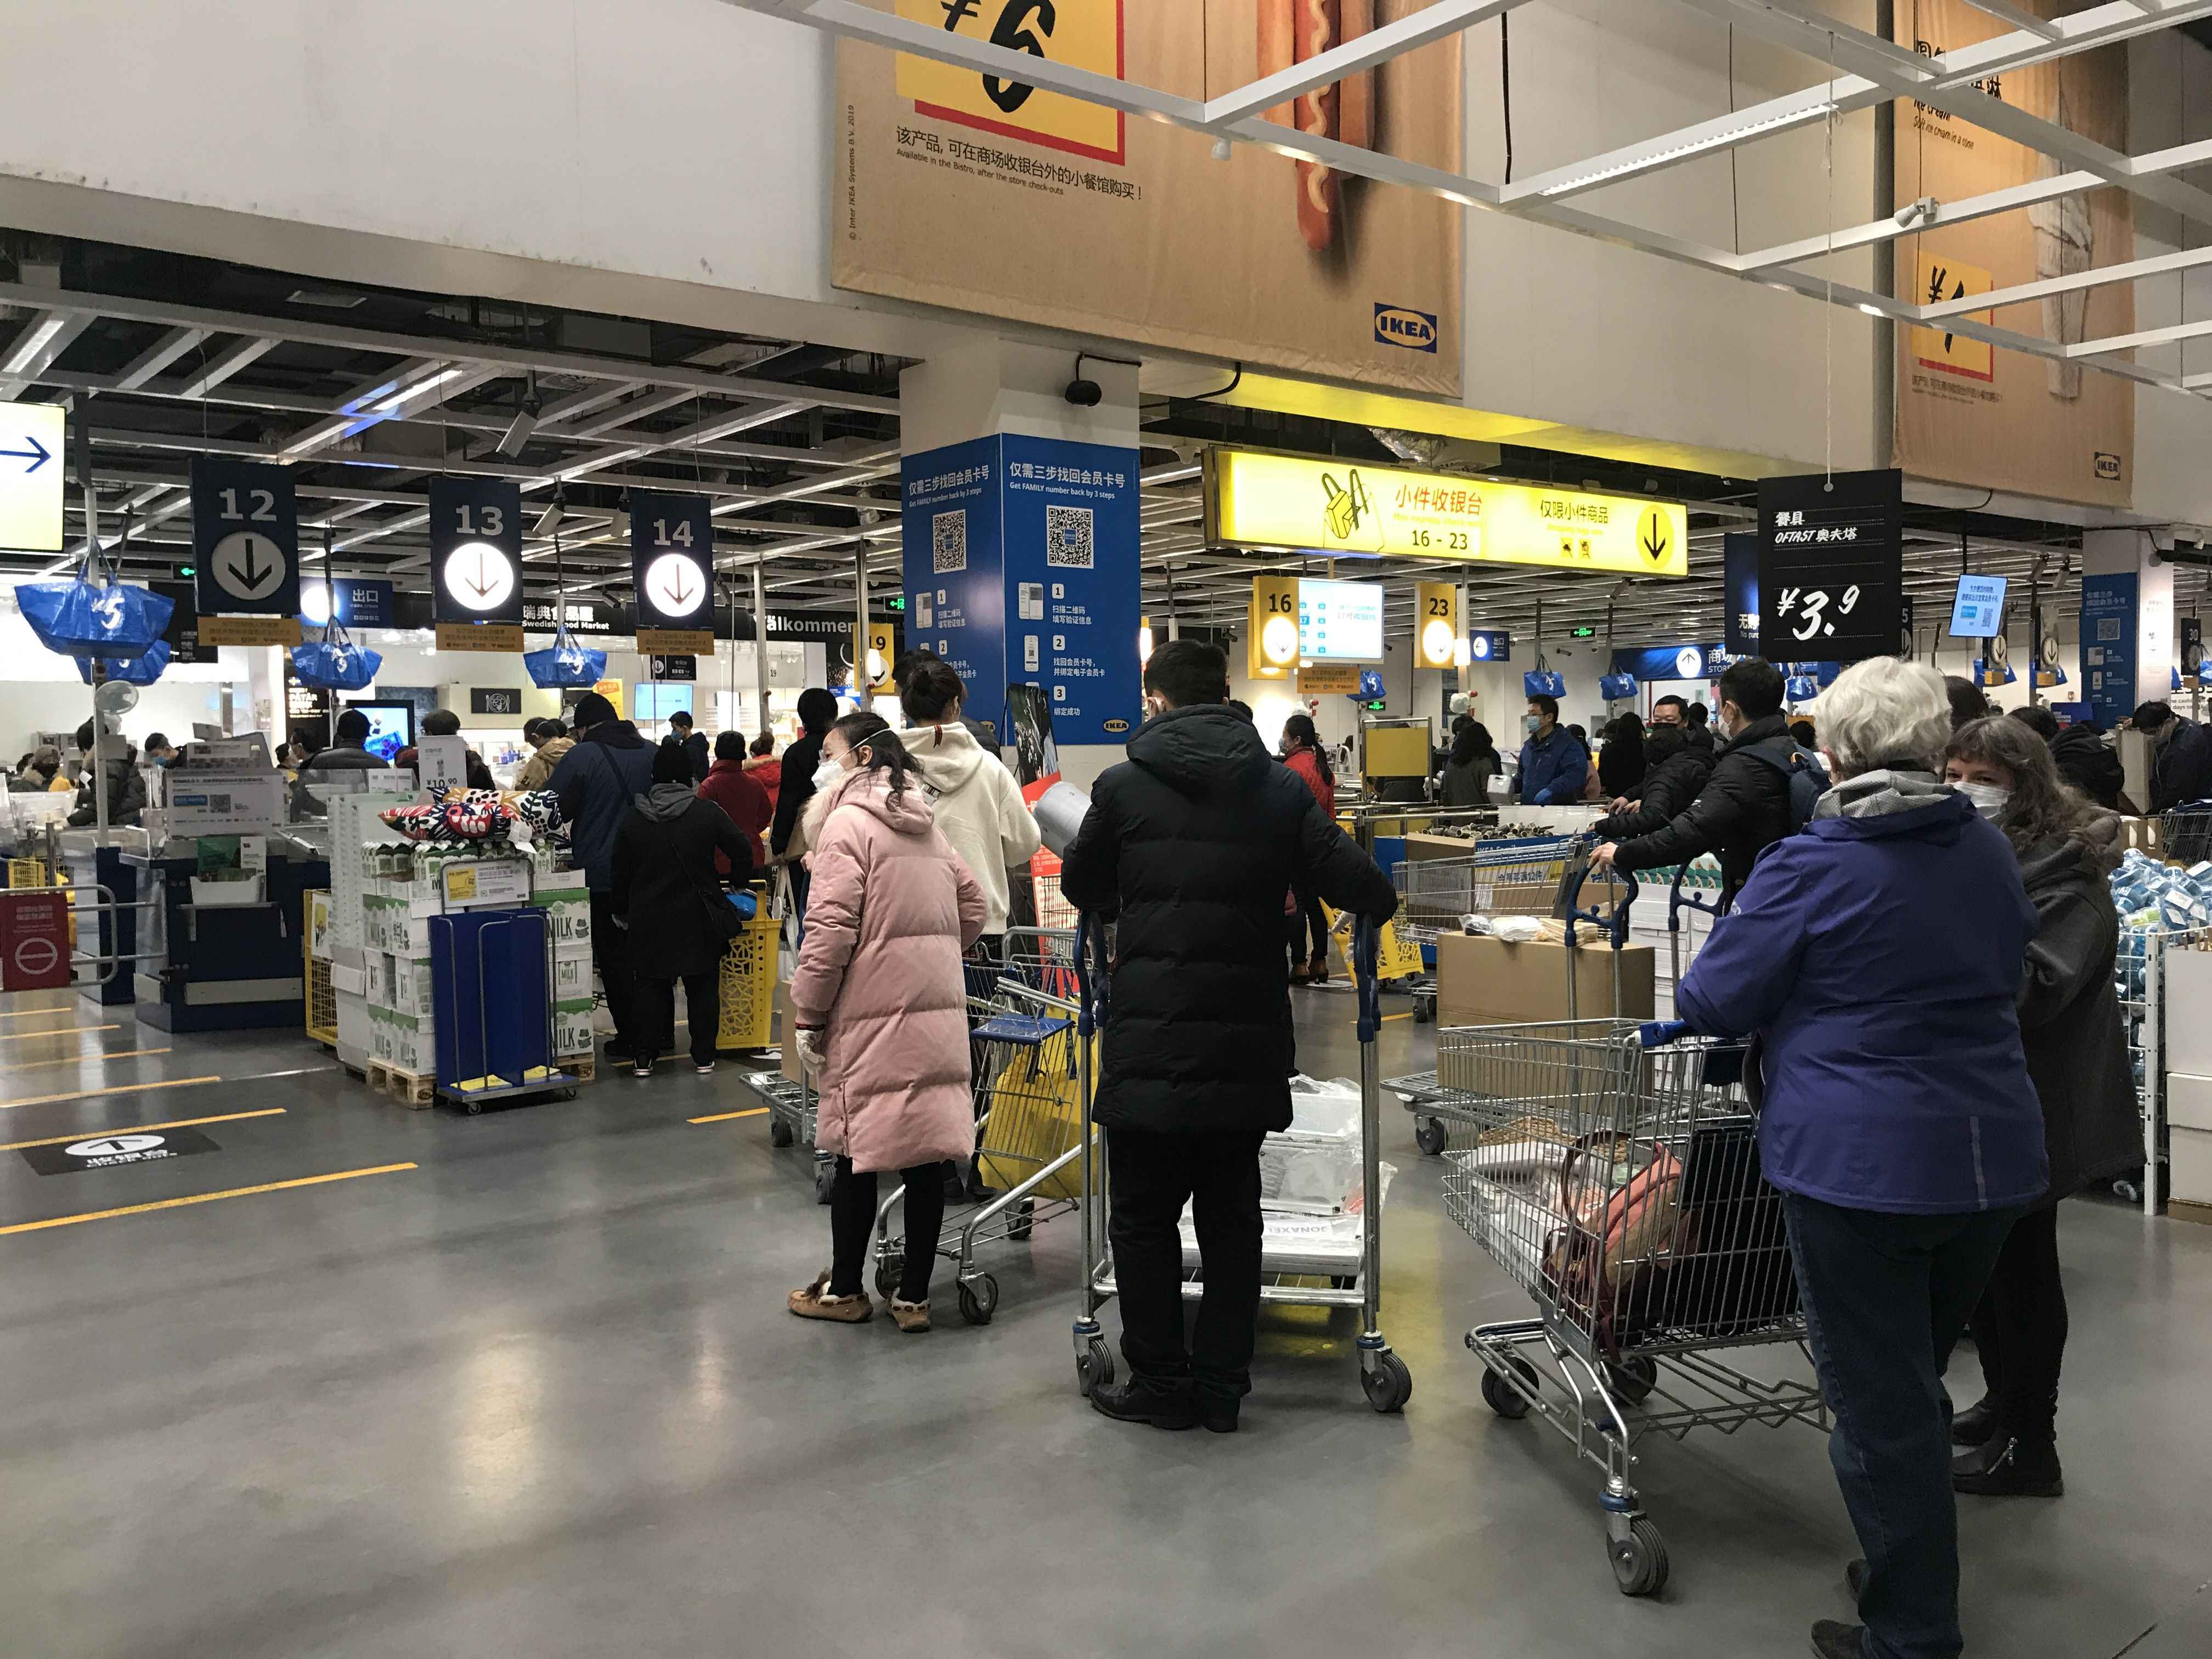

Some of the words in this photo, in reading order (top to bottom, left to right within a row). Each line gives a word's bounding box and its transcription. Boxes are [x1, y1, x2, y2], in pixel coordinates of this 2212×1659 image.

[896, 148, 928, 163] Available
[930, 156, 937, 165] in
[939, 159, 952, 168] the
[953, 161, 975, 175] Bistro,
[977, 167, 995, 179] after
[996, 174, 1008, 182] the
[1009, 176, 1027, 187] store
[1381, 315, 1431, 341] IKEA
[2097, 459, 2118, 473] IKEA
[909, 465, 990, 496] 仅需三步找回会员卡号
[1009, 461, 1125, 488] 仅需三步找回会员卡号
[932, 493, 949, 503] number
[949, 490, 959, 499] back
[960, 489, 966, 498] by
[969, 487, 982, 496] steps
[1009, 482, 1021, 490] Get
[1022, 483, 1045, 492] FAMILY
[1046, 486, 1070, 494] number
[1070, 488, 1085, 496] back
[1086, 490, 1094, 499] by
[1099, 492, 1115, 500] steps
[219, 488, 277, 522] 12
[1395, 484, 1482, 516] 小件收银台
[1540, 500, 1609, 524] 仅限小件商品
[1774, 510, 1805, 527] 餐具
[456, 504, 504, 536] 13
[653, 519, 694, 548] 14
[1412, 530, 1430, 547] 16
[1449, 533, 1468, 550] 23
[1774, 530, 1817, 544] OFTAST
[1815, 527, 1858, 543] 奥夫塔
[352, 588, 379, 603] 出口
[940, 592, 943, 602] 1
[1056, 587, 1060, 596] 1
[1052, 605, 1086, 615] 扫描二维码
[1268, 593, 1292, 613] 16
[1429, 597, 1449, 617] 23
[581, 622, 610, 630] Market
[1052, 615, 1092, 625] 填写验证信息
[1493, 636, 1504, 646] 出口
[2188, 628, 2199, 641] 30
[941, 644, 945, 652] 2
[1056, 639, 1062, 647] 2
[1053, 657, 1096, 668] 找回会员卡号，
[770, 669, 777, 678] 19
[1053, 667, 1105, 677] 并绑定电子会员卡
[1057, 689, 1063, 698] 3
[1054, 707, 1080, 716] 绑定成功
